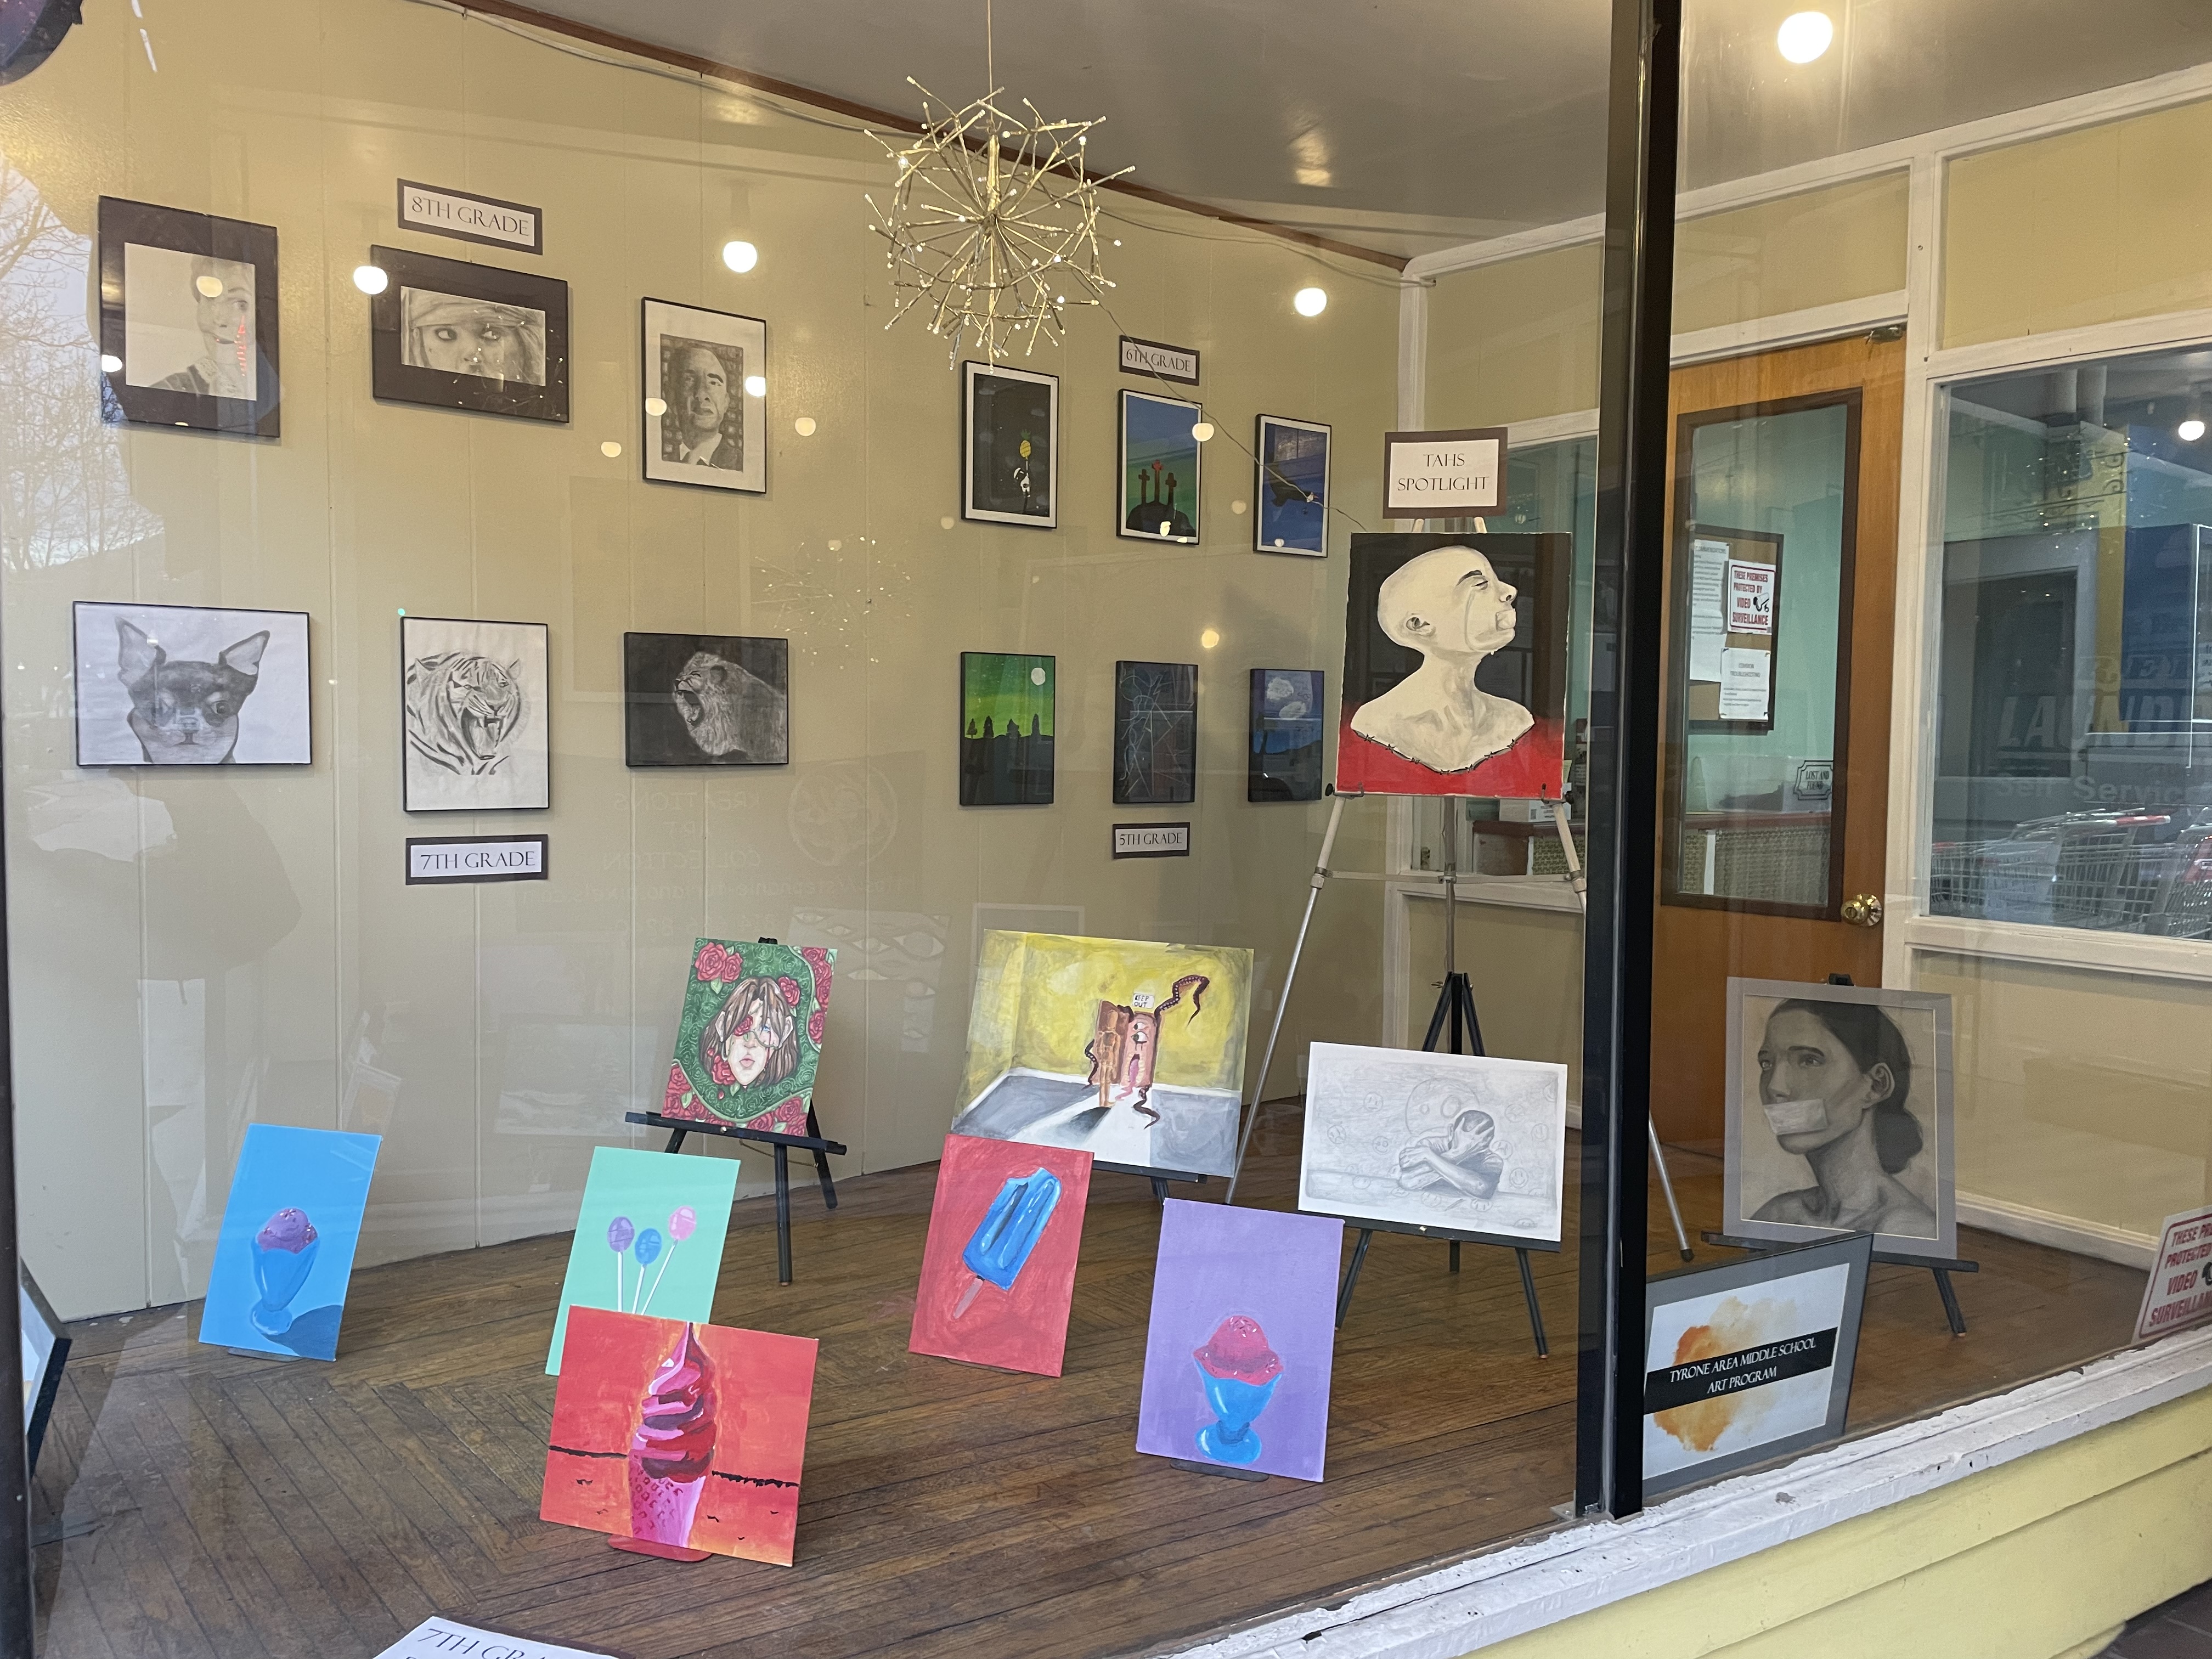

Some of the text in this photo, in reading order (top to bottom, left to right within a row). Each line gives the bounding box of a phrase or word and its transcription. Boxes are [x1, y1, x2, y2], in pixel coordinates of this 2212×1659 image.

[411, 196, 529, 236] 8TH GRADE
[1126, 348, 1191, 373] 6TH GRADE
[1423, 453, 1465, 467] TAHS
[1397, 476, 1489, 491] SPOTLIGHT
[1757, 585, 1763, 594] BY
[1737, 597, 1751, 609] VIDEO
[1733, 612, 1769, 625] SURVEILLANCE
[1119, 832, 1182, 845] 5TH GRADE
[420, 851, 535, 870] 7TH GRADE
[2167, 1270, 2198, 1295] VIDEO
[1670, 1337, 1816, 1383] TYRONE AREA MIDDLE SCHOOL
[1707, 1365, 1777, 1394] ART PROGRAM
[417, 1628, 480, 1655] 7TH
